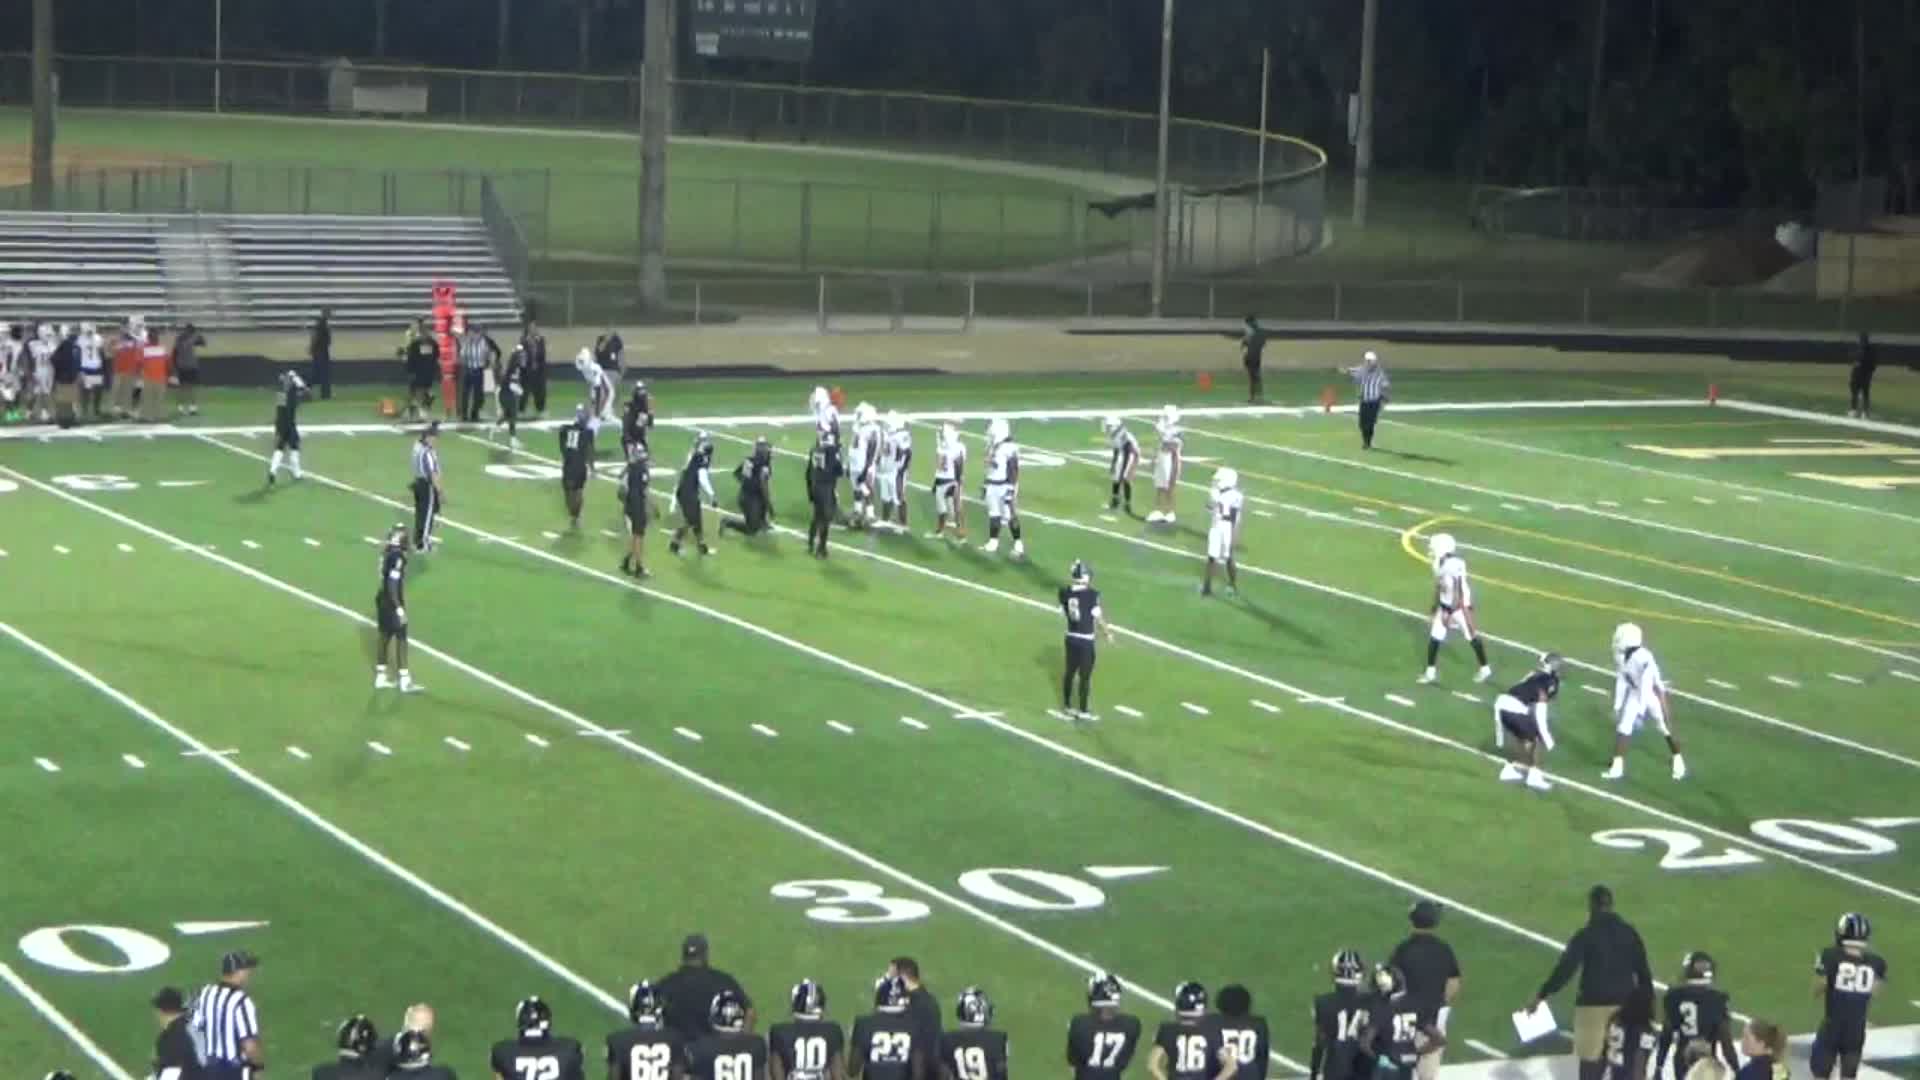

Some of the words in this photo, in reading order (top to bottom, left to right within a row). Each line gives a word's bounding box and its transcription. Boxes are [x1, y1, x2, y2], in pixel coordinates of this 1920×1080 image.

[1591, 819, 1898, 869] 20
[770, 868, 1105, 923] 30
[1836, 962, 1875, 993] 20
[1392, 1012, 1417, 1042] 15
[1680, 1001, 1698, 1036] 3
[630, 1043, 671, 1080] 62
[794, 1037, 827, 1069] 10
[870, 1031, 911, 1062] 23
[1089, 1032, 1126, 1067] 17
[1176, 1035, 1207, 1072] 16
[1221, 1029, 1257, 1063] 50
[515, 1056, 559, 1080] 72
[714, 1053, 752, 1080] 60
[953, 1047, 987, 1080] 19
